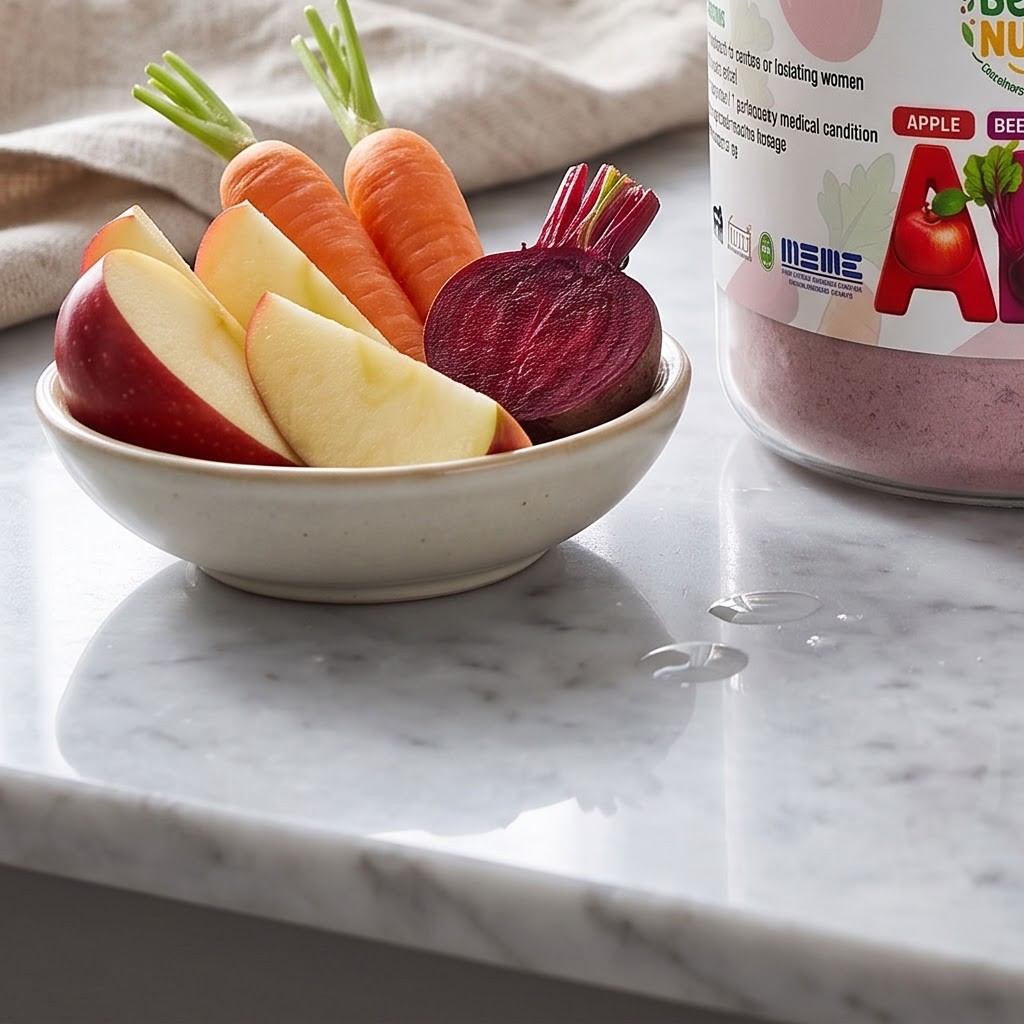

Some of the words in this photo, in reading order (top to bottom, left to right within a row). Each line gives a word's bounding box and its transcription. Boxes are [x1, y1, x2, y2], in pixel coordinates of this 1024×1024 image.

[763, 59, 772, 73] or
[821, 71, 864, 90] women
[780, 113, 819, 134] medical
[907, 114, 960, 133] APPLE
